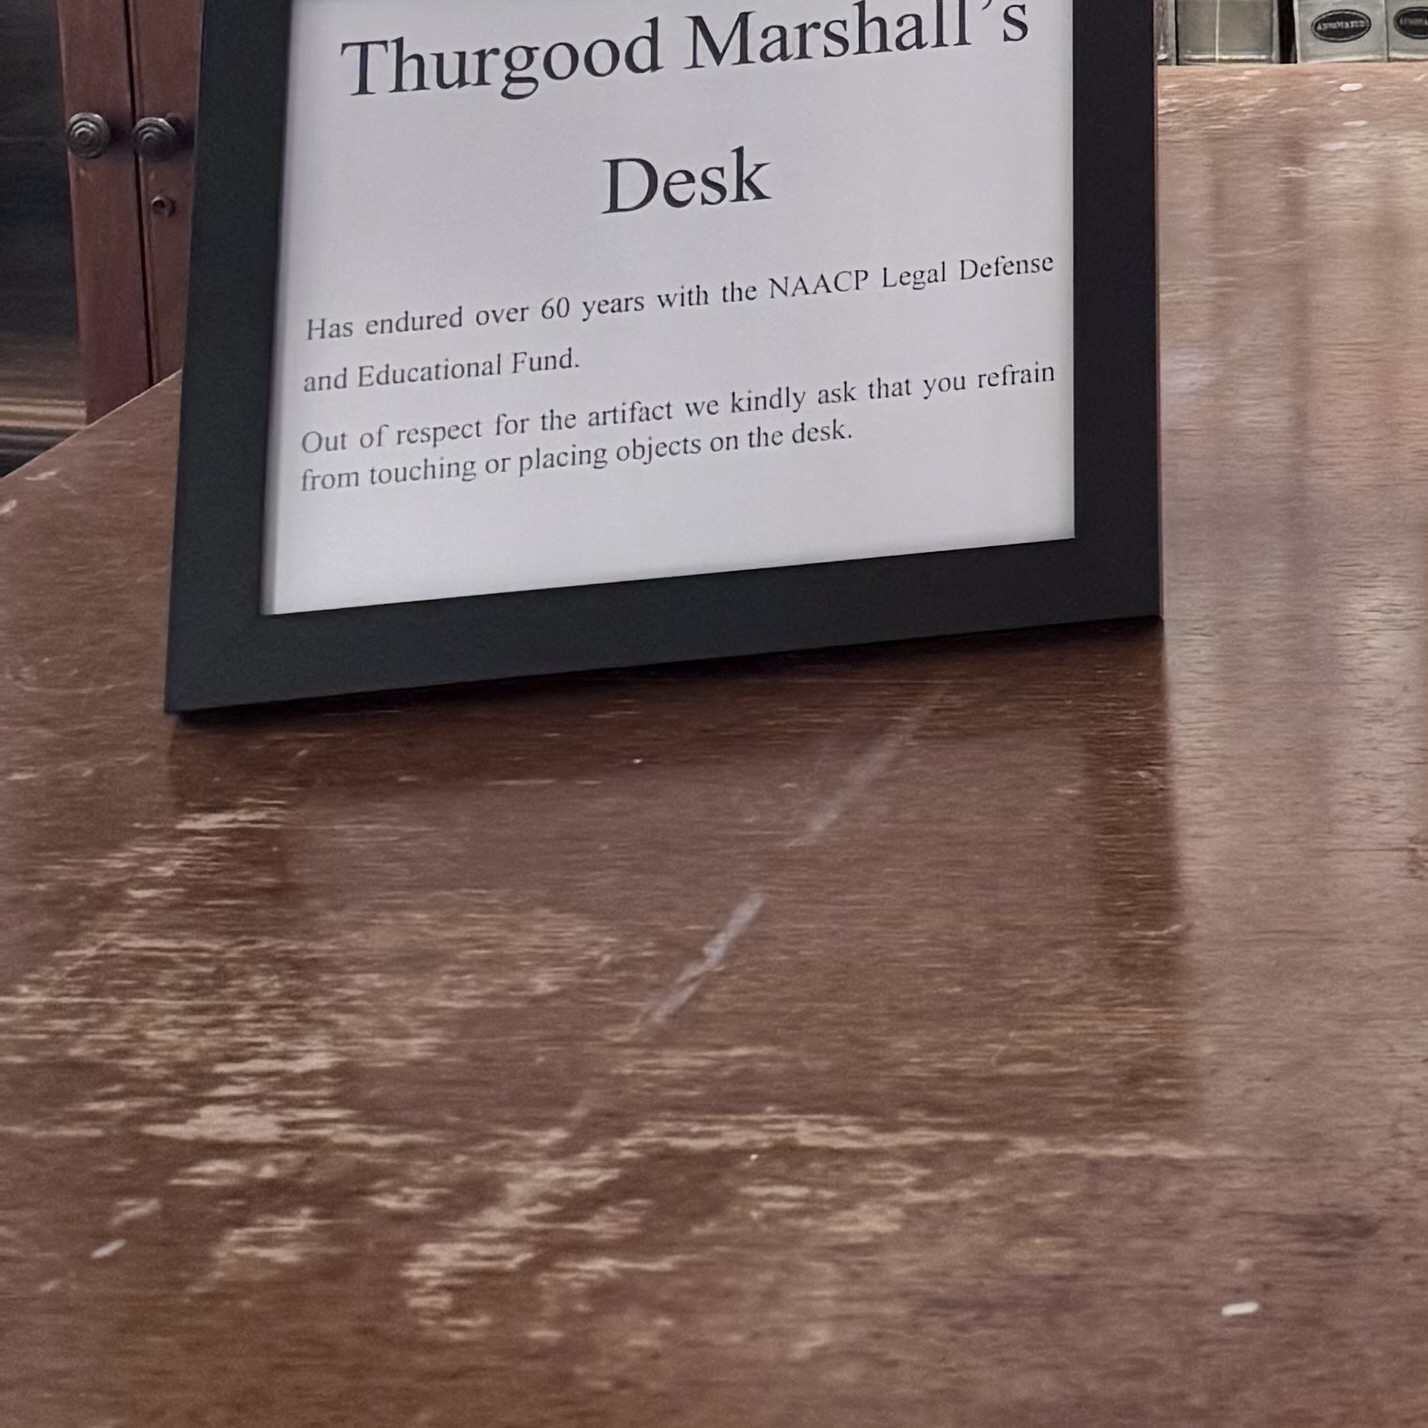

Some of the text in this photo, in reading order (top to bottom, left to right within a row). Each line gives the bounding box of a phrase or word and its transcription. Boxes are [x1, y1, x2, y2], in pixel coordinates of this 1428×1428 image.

[340, 15, 665, 101] Thurgood
[601, 145, 773, 215] Desk
[305, 254, 1054, 341] Has endured over 60 years with the NAACP Legal Defense
[301, 360, 1055, 454] Out of respect for the artifact we kindly ask that you refrain
[303, 346, 580, 393] and Educational Fund.
[300, 417, 853, 492] from touching or placing objects on the desk.
